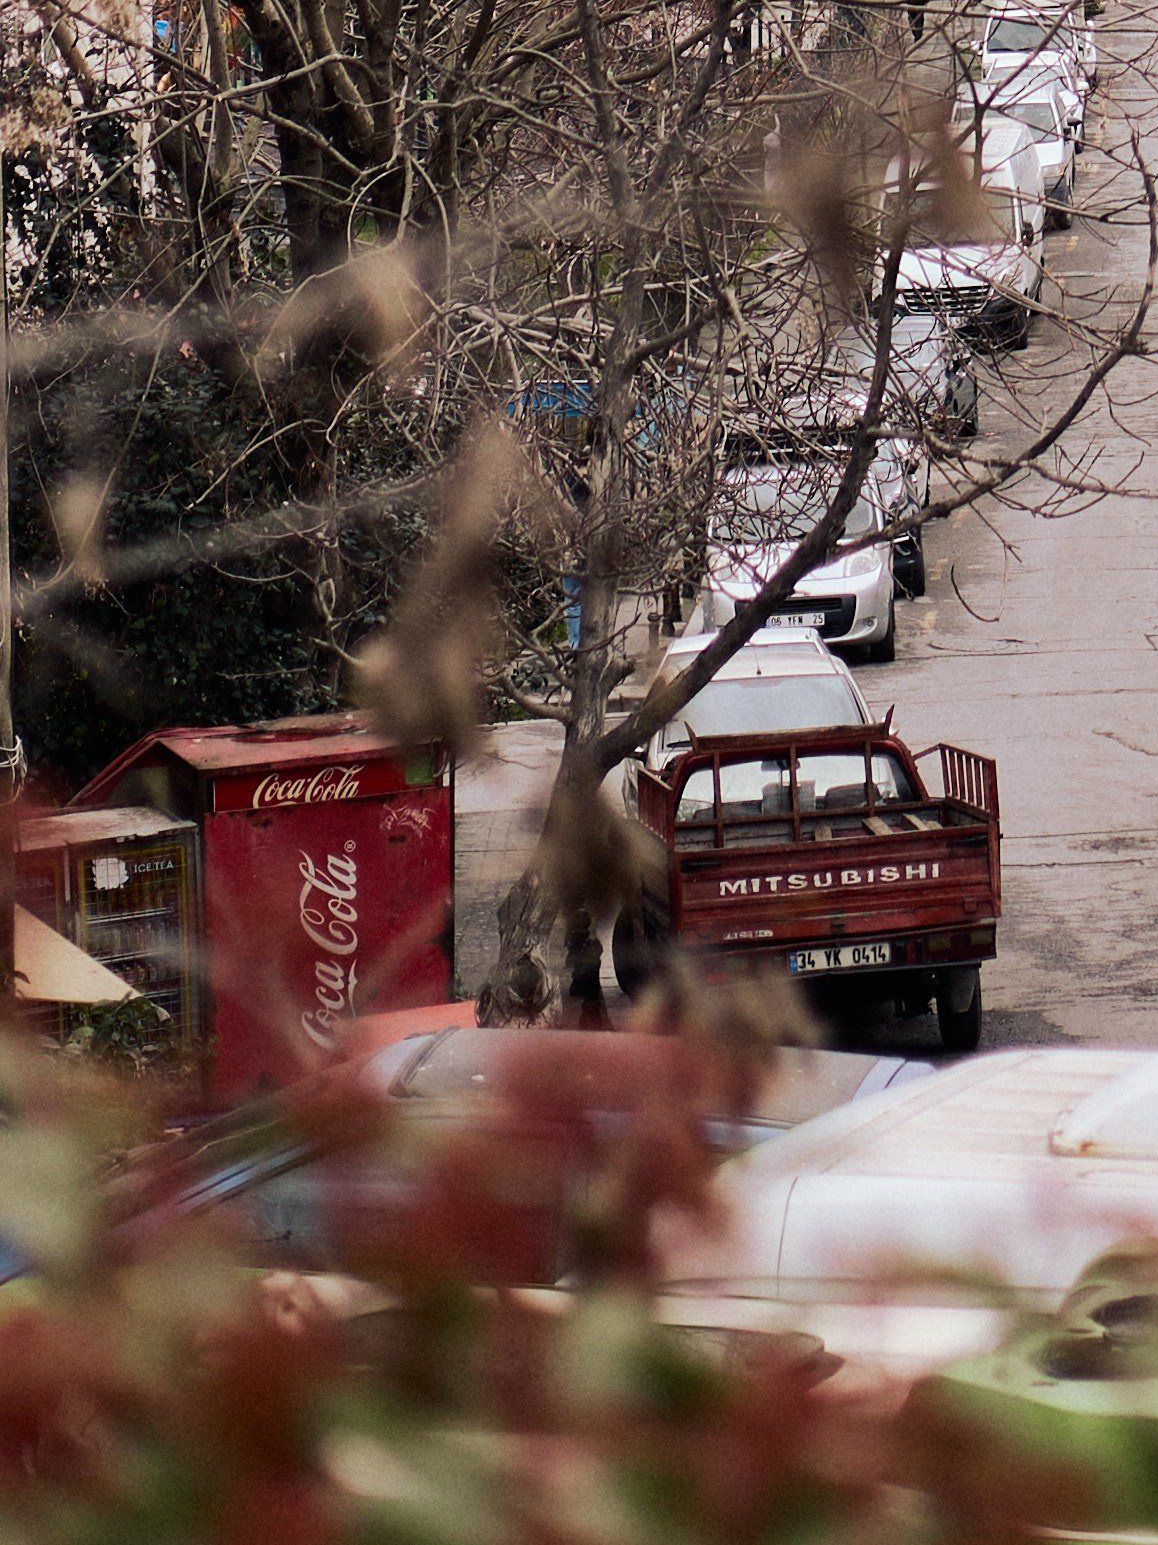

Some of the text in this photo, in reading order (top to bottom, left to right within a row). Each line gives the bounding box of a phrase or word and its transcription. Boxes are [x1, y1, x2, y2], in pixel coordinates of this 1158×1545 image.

[813, 614, 823, 624] 25
[252, 764, 365, 808] Coca-Cola
[134, 860, 174, 873] ICE TEA
[719, 863, 941, 896] MITSUBISHI
[797, 945, 887, 970] 34 YK 0414
